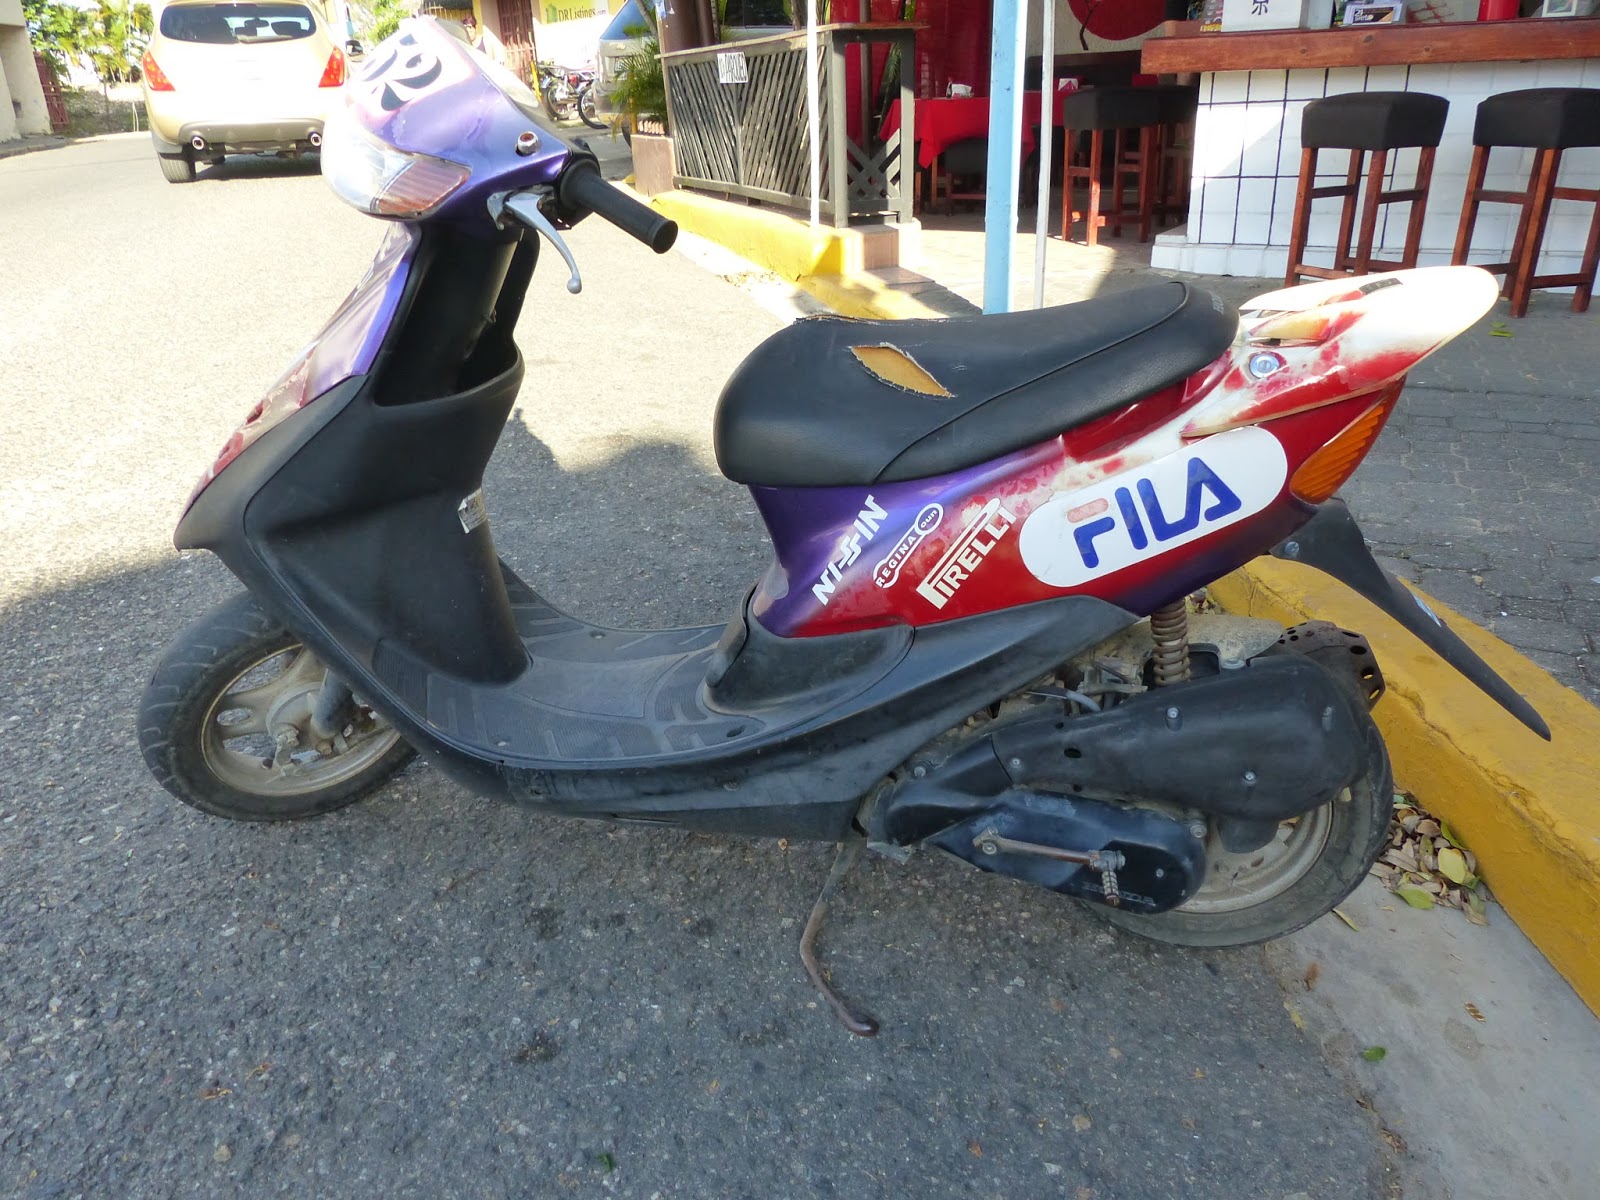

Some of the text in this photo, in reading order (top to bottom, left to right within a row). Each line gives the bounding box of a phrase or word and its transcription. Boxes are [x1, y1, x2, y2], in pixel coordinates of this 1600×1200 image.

[812, 494, 888, 606] NISSIN
[875, 535, 917, 588] REGINA
[916, 498, 1016, 610] PIRELLI
[1067, 457, 1242, 569] FILA
